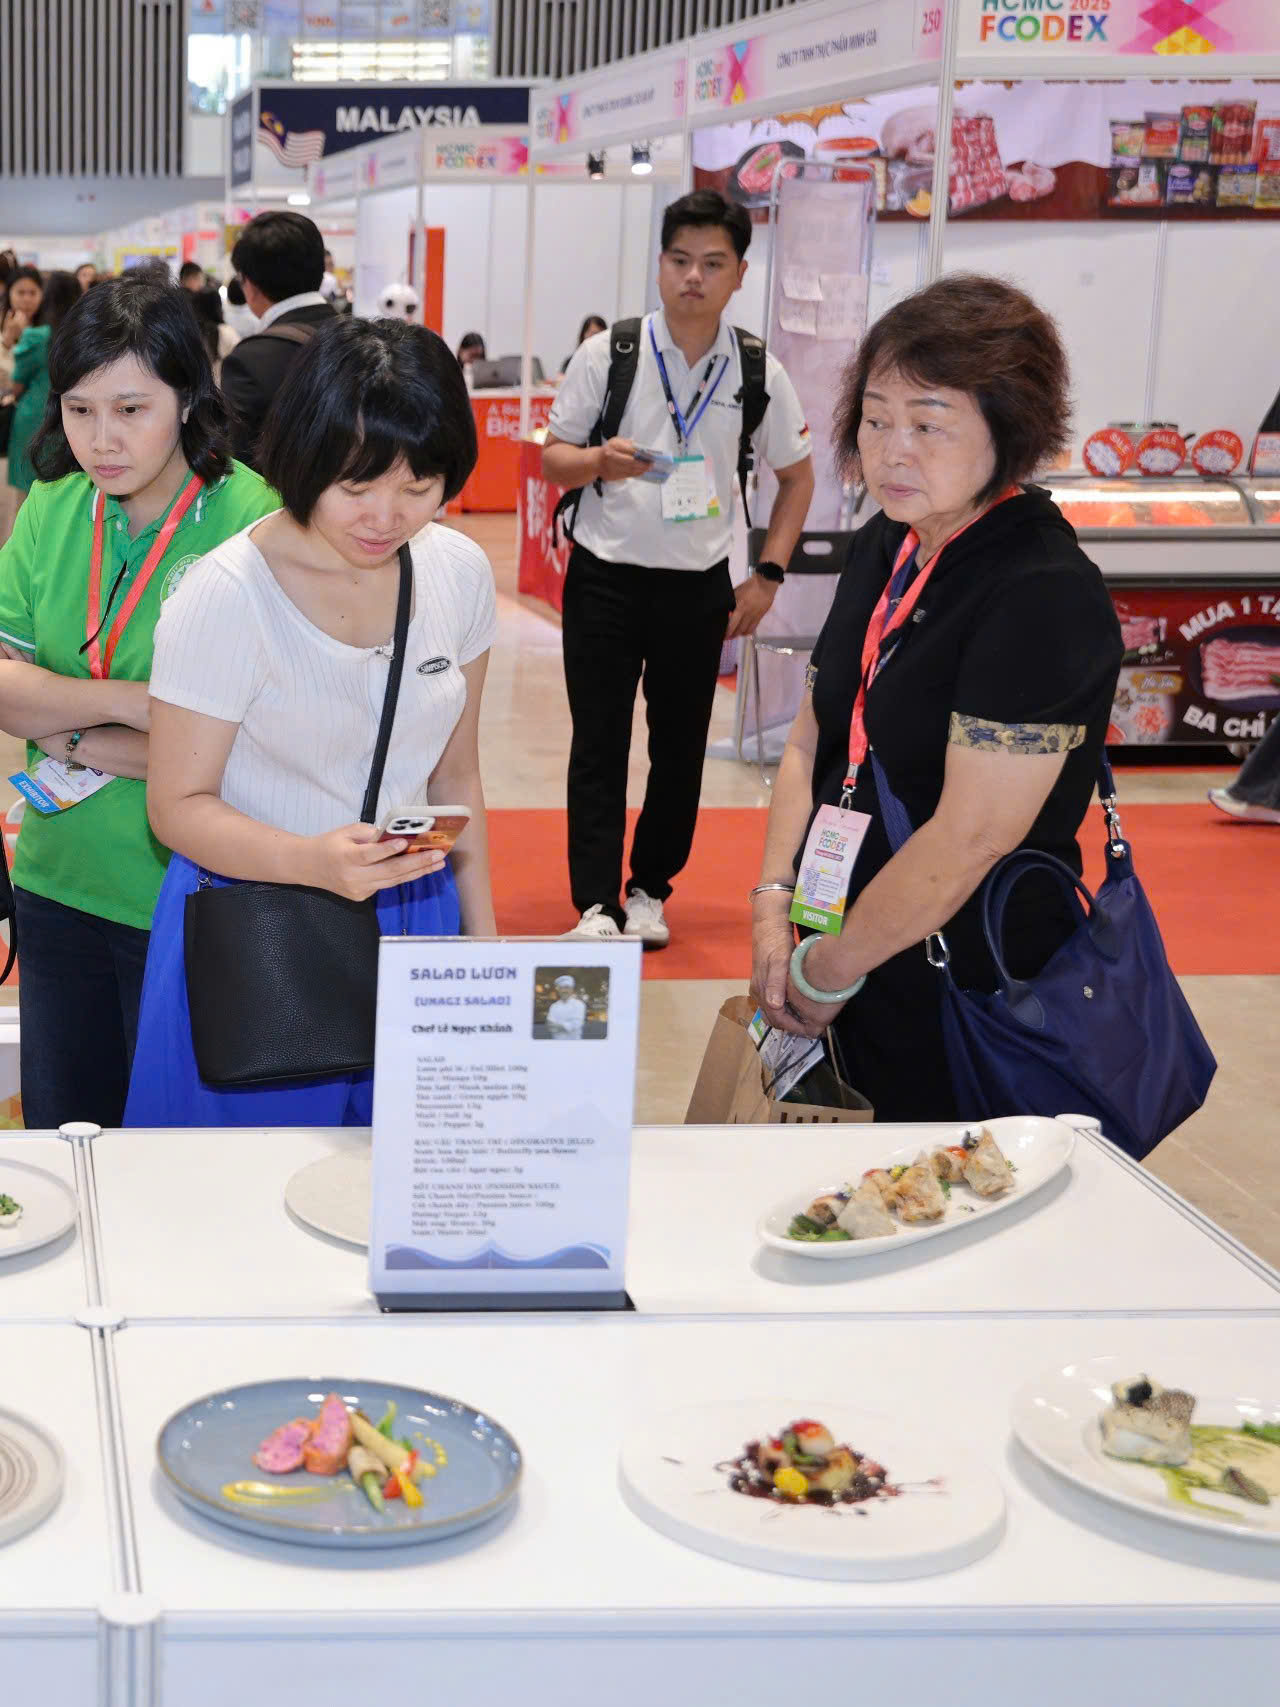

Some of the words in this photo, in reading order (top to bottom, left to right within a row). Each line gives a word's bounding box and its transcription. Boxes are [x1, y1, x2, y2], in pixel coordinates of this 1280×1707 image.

[922, 8, 942, 35] 250
[335, 105, 482, 133] MALAYSIA
[1152, 435, 1178, 446] SALE
[1213, 433, 1238, 448] SALE
[1178, 600, 1236, 642] MUA
[1240, 596, 1251, 616] 1
[1182, 704, 1217, 734] BA
[1222, 711, 1267, 738] CHỈ
[19, 780, 50, 808] EXHIBITOR
[802, 909, 829, 926] VISITOR
[410, 968, 466, 980] SALAD
[412, 1023, 435, 1033] Chef
